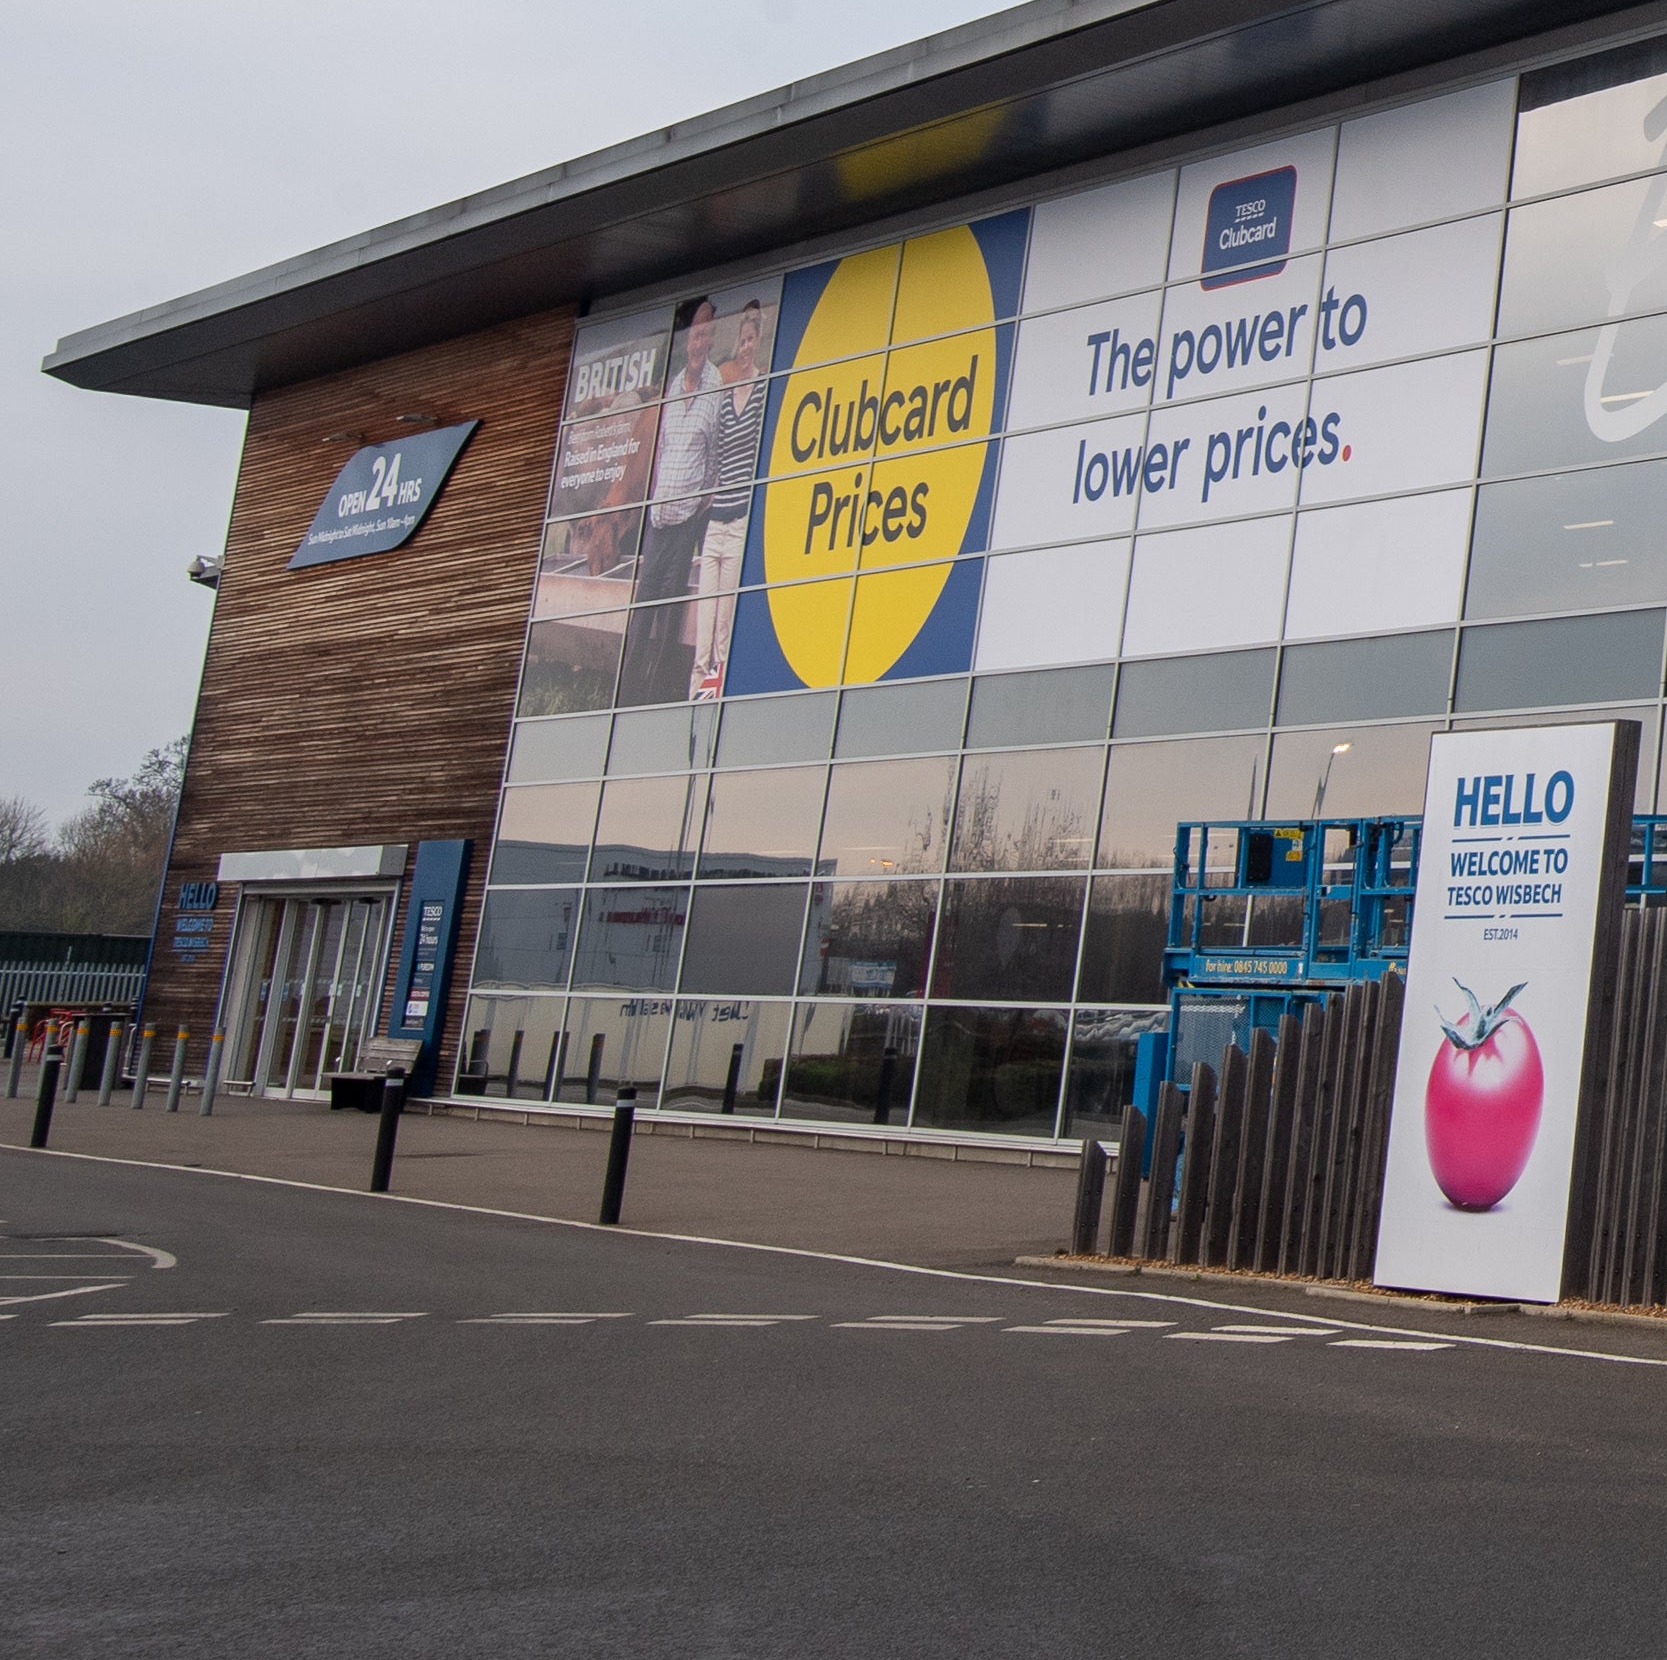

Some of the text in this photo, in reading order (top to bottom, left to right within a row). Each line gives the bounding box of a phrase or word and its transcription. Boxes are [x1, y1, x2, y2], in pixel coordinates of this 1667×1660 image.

[1235, 199, 1266, 217] TESCO
[1219, 216, 1277, 250] Clubcard
[1086, 285, 1368, 400] The power to
[575, 348, 656, 403] BRITISH
[790, 354, 978, 464] Clubcard
[564, 437, 640, 467] Raised in England for
[1073, 403, 1353, 504] lower prices.
[338, 453, 422, 517] OPEN 24 HRS
[561, 462, 627, 489] everyone to enjoy
[803, 473, 928, 556] Prices
[1454, 770, 1575, 827] HELLO
[1450, 848, 1568, 877] WELCOME TO
[179, 882, 217, 909] HELLO
[1447, 883, 1562, 906] TESCO WISBECH
[423, 906, 442, 917] TESCO
[1253, 961, 1268, 974] 745
[1269, 961, 1287, 974] 0000
